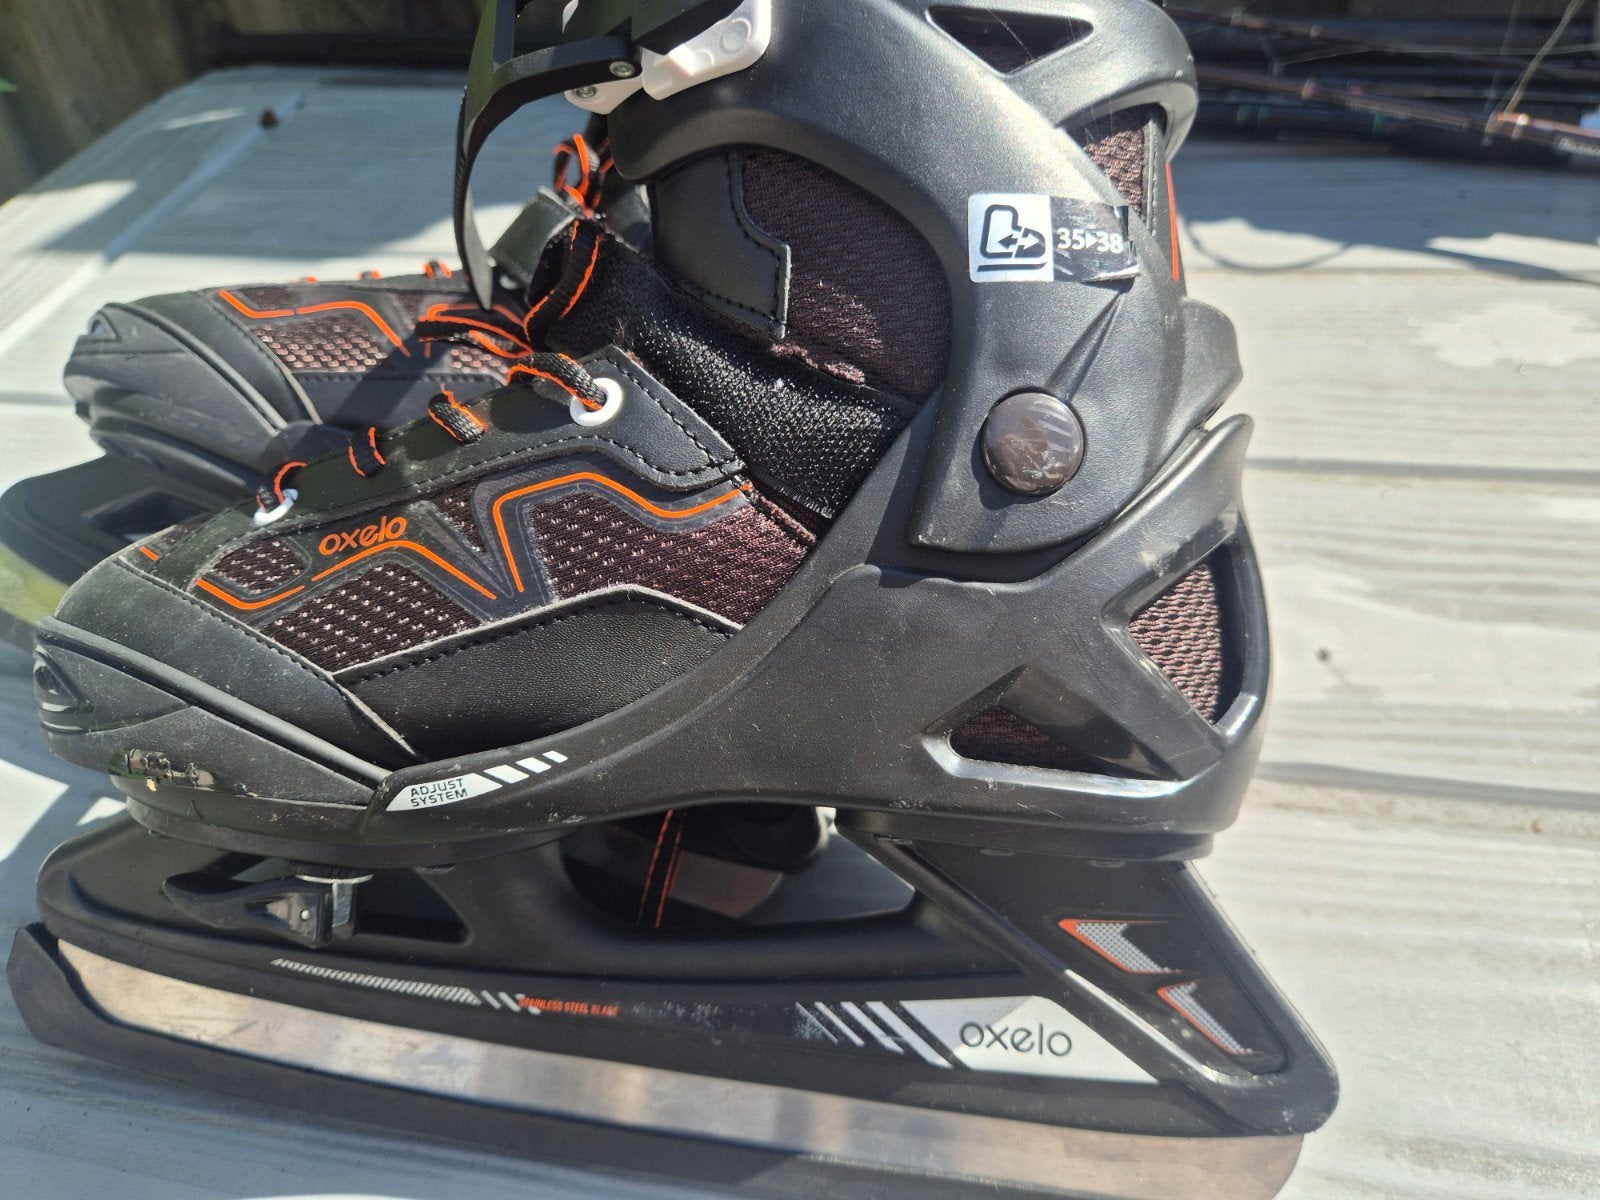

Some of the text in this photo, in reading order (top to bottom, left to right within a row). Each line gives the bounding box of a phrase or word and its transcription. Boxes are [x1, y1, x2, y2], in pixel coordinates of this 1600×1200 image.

[319, 516, 407, 555] oxelo
[410, 778, 463, 798] ADJUST
[410, 788, 468, 807] SYSTEM
[564, 1001, 588, 1014] STEEL
[960, 1021, 1072, 1057] oxelo
